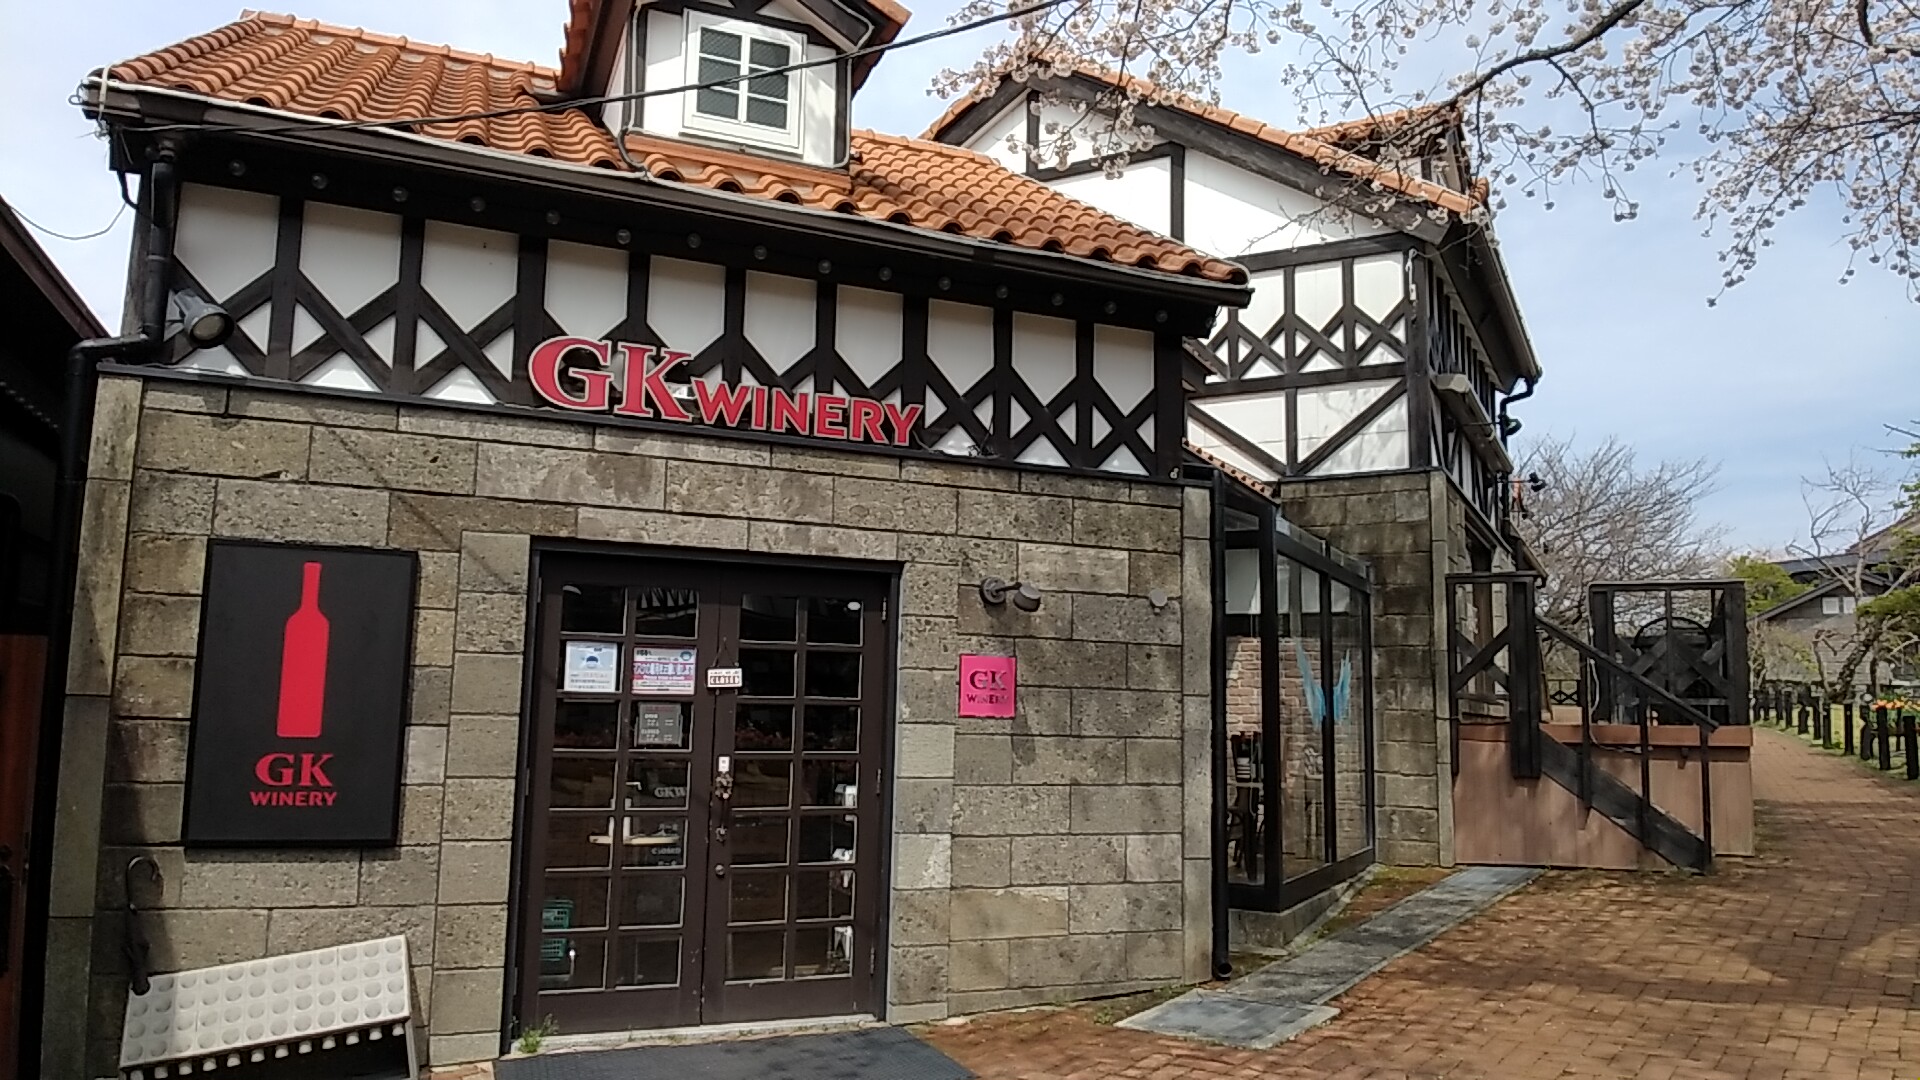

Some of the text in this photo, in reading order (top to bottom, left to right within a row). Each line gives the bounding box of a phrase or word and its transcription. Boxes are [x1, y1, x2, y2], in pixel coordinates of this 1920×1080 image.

[527, 335, 923, 446] GK WINERY
[969, 670, 1007, 691] GK
[255, 753, 334, 787] GK
[250, 790, 337, 807] WINERY
